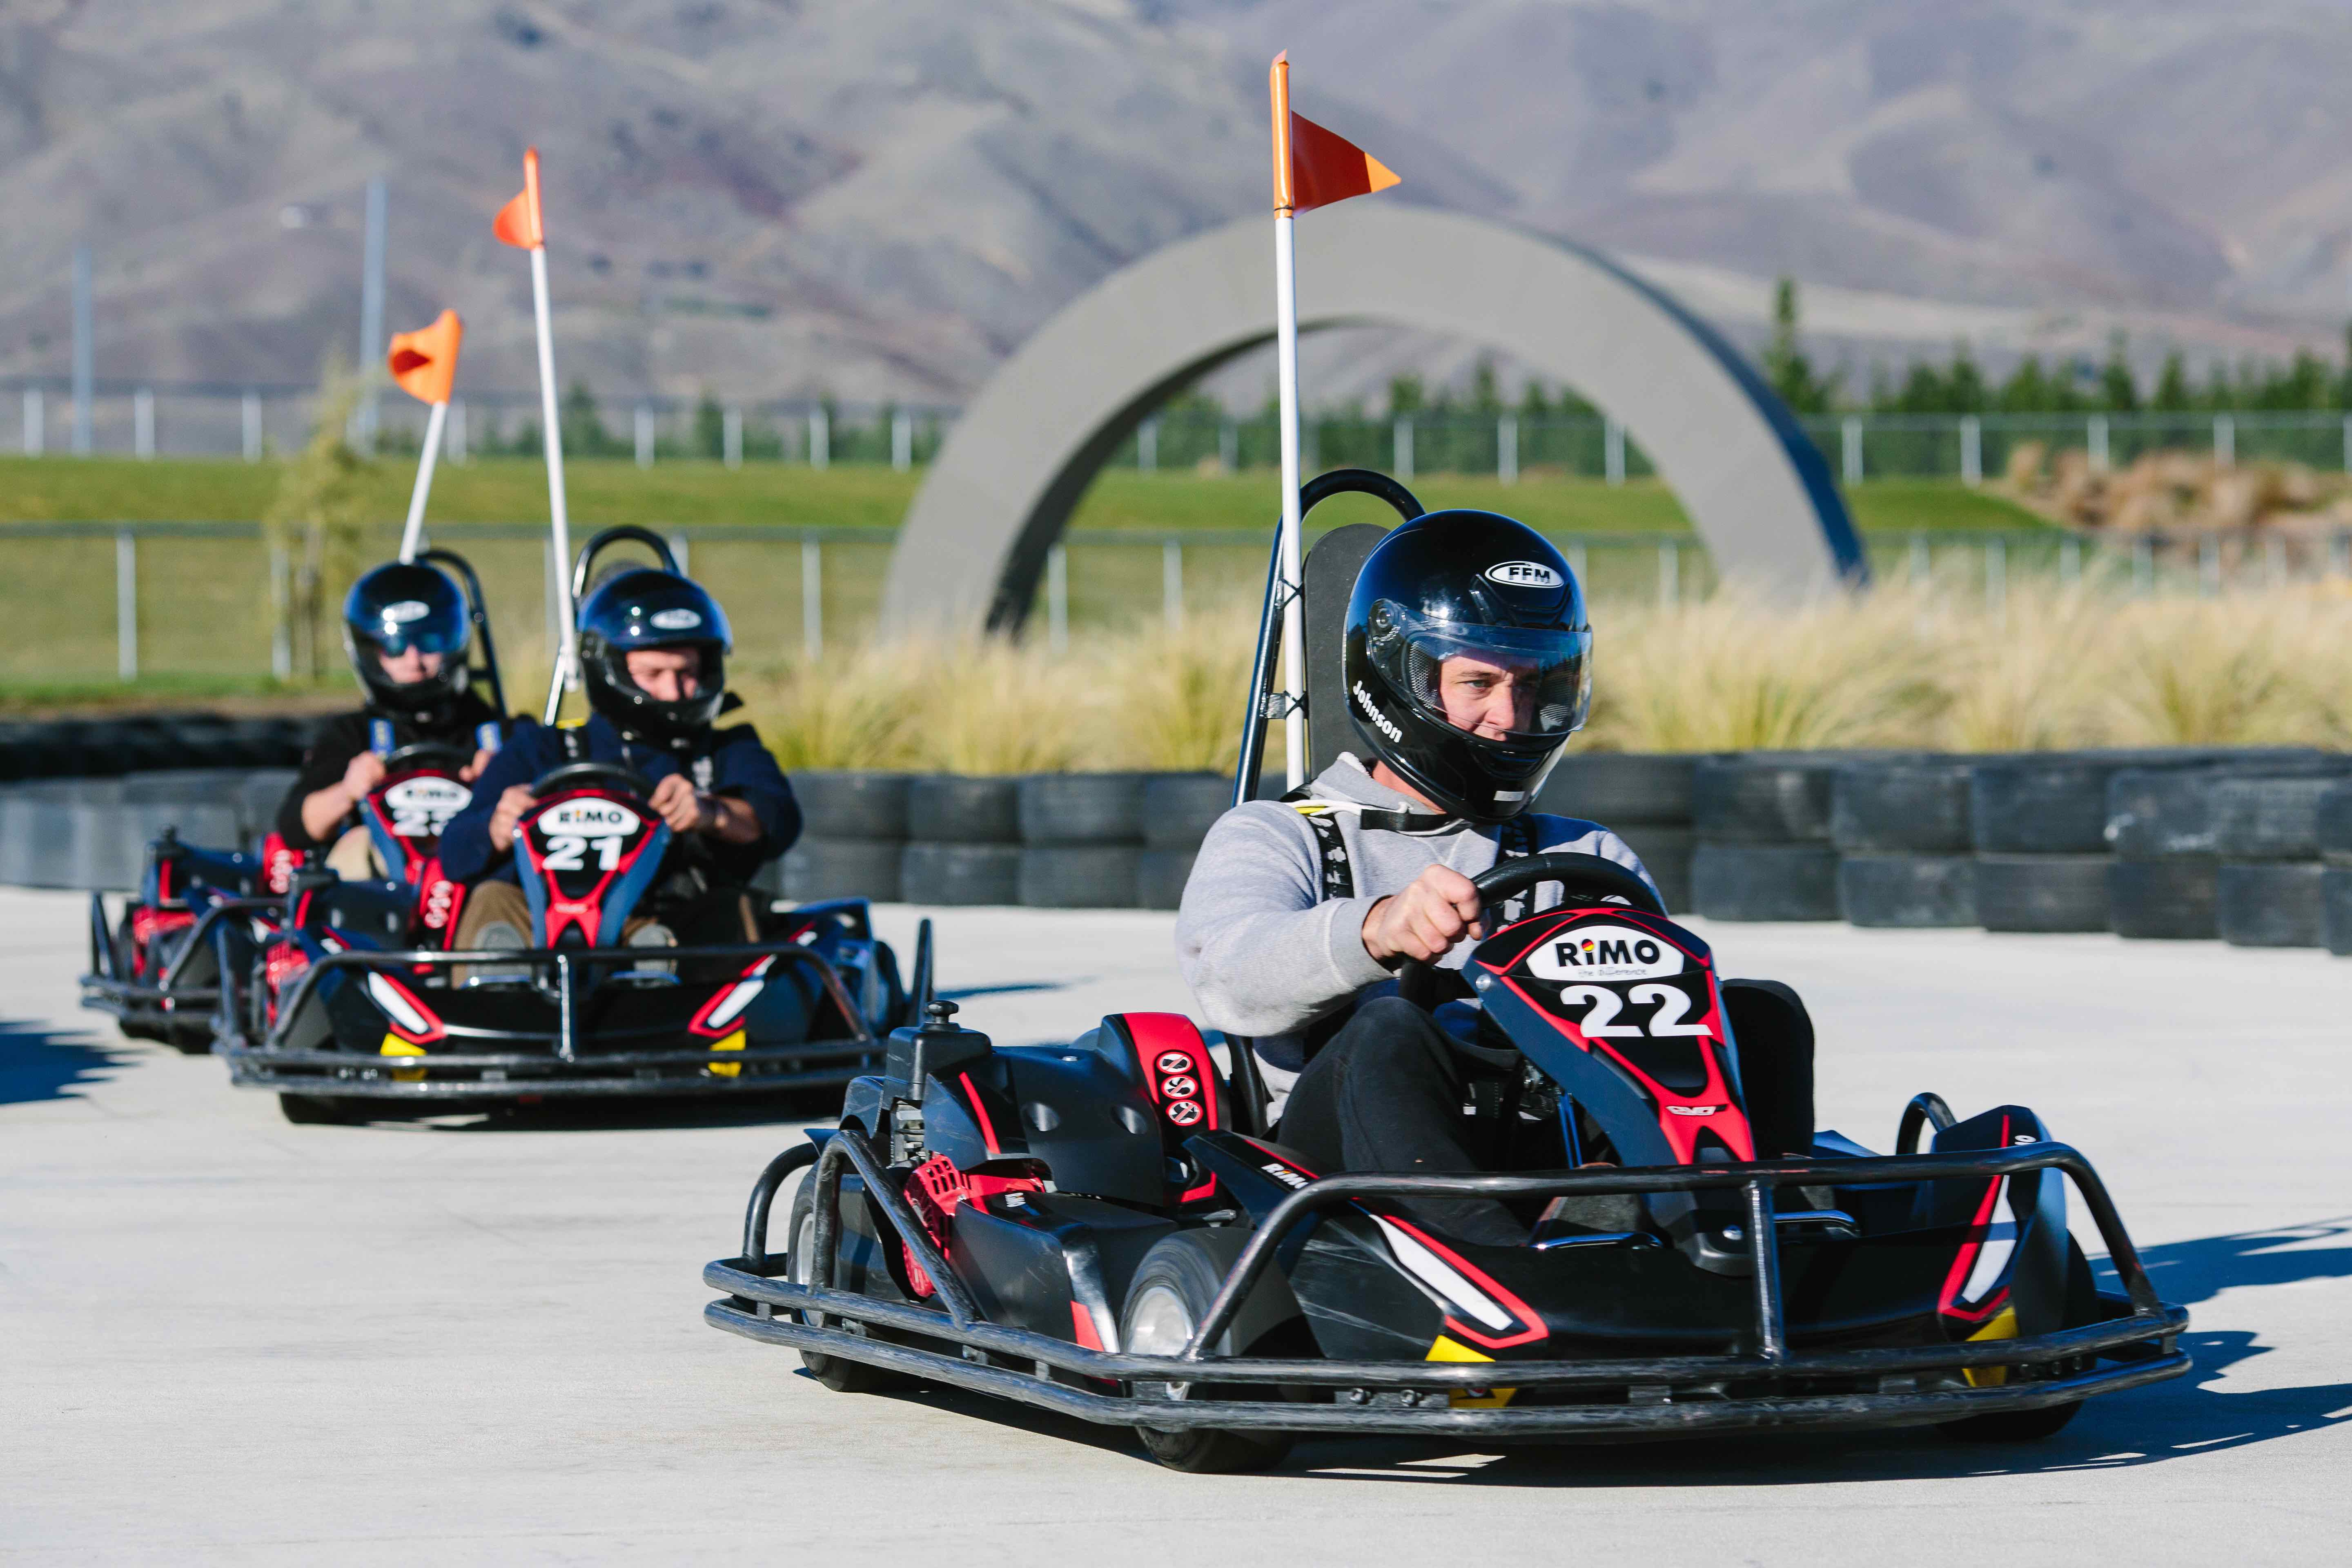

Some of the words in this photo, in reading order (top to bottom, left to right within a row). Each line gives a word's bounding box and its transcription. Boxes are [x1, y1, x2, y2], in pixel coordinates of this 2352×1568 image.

[1509, 567, 1550, 583] FFM
[1353, 680, 1403, 743] Johnson
[542, 835, 623, 871] 21
[1560, 983, 1714, 1038] 22
